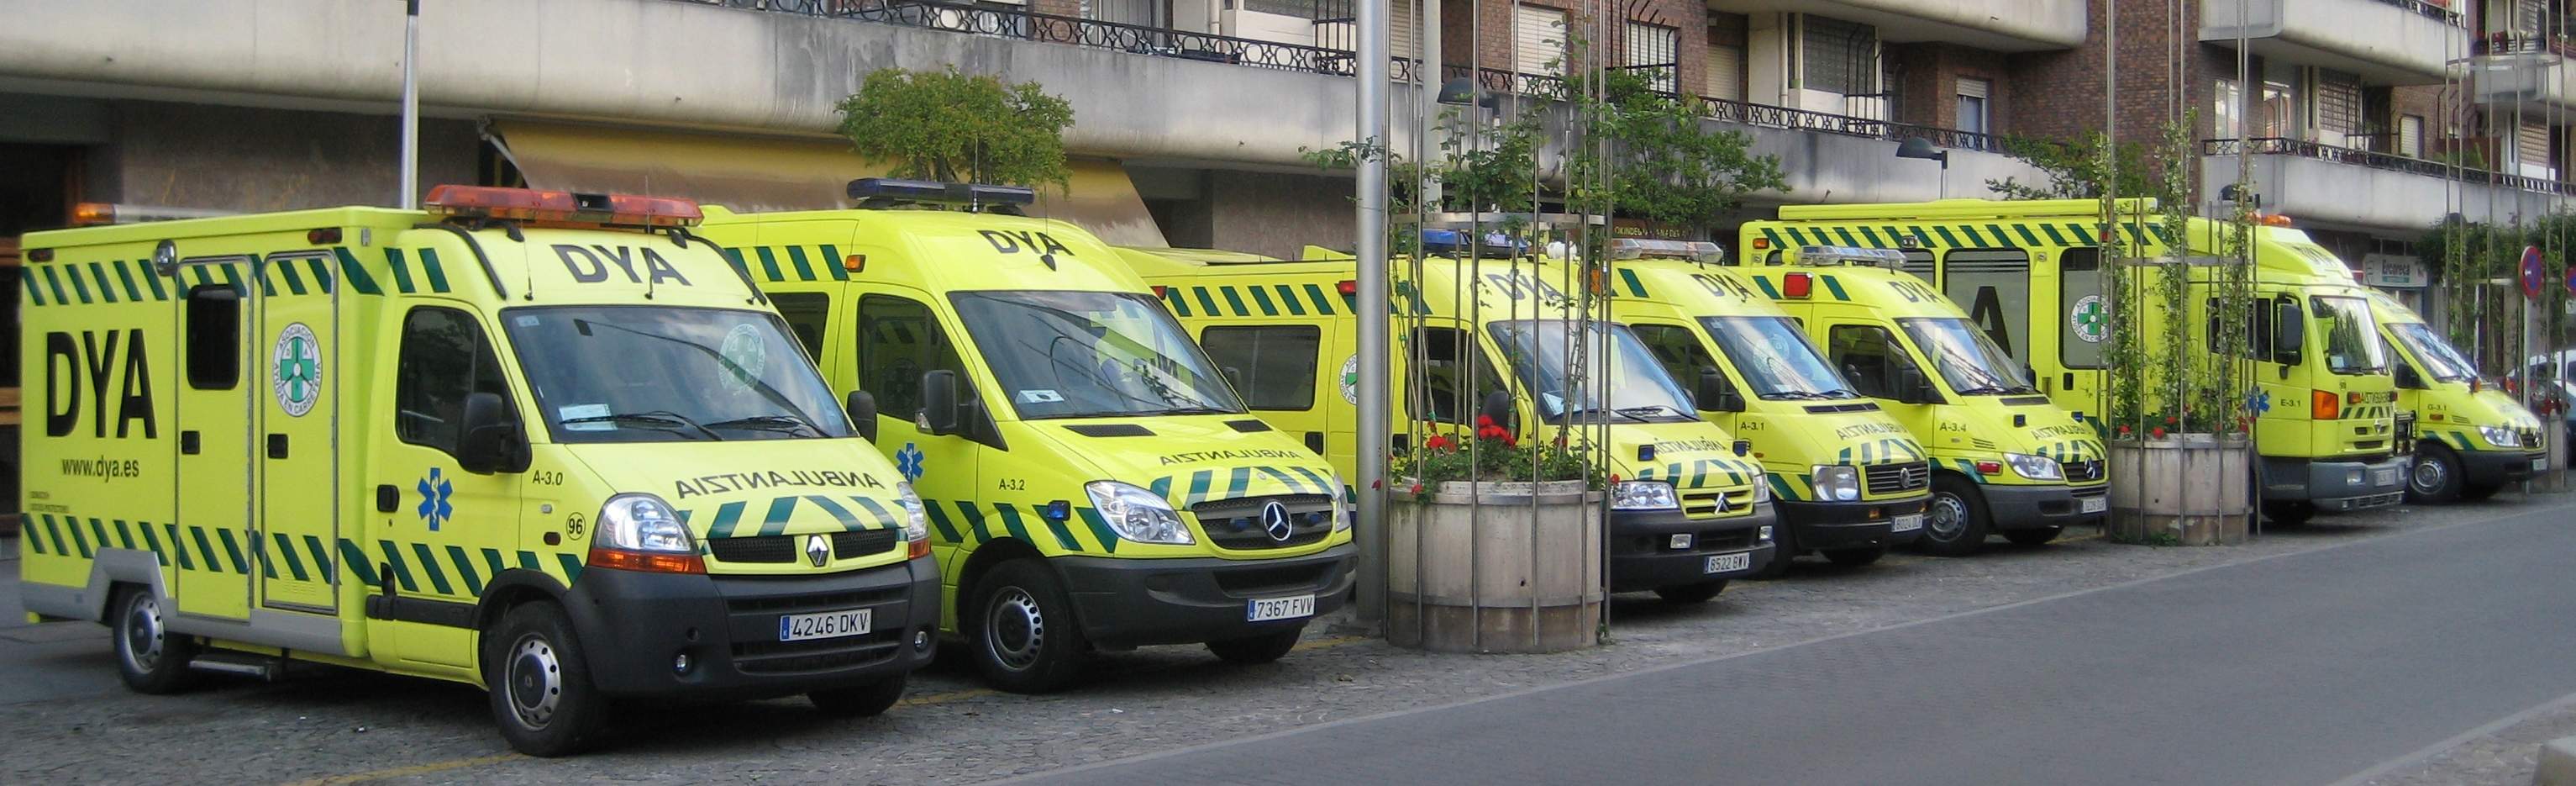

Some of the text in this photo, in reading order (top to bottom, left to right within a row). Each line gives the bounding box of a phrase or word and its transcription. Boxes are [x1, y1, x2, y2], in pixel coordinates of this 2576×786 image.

[977, 229, 1075, 256] DYA
[549, 244, 693, 286] DYA
[1484, 274, 1564, 300] DYA
[1689, 273, 1757, 298] DYA
[1888, 281, 1946, 303] DYA
[1971, 285, 2013, 359] A
[47, 328, 158, 440] DYA
[2280, 398, 2301, 407] E-3.1
[1740, 421, 1765, 431] A-3.1
[1939, 422, 1968, 432] A-3.4
[61, 454, 140, 483] www.dya.es
[532, 470, 563, 487] A-3.0
[998, 477, 1025, 491] A-3.2
[568, 518, 584, 535] 96
[1710, 557, 1731, 572] 8522
[1257, 598, 1312, 618] 7367 FVV
[792, 615, 834, 637] 4246
[840, 613, 869, 633] DKV
